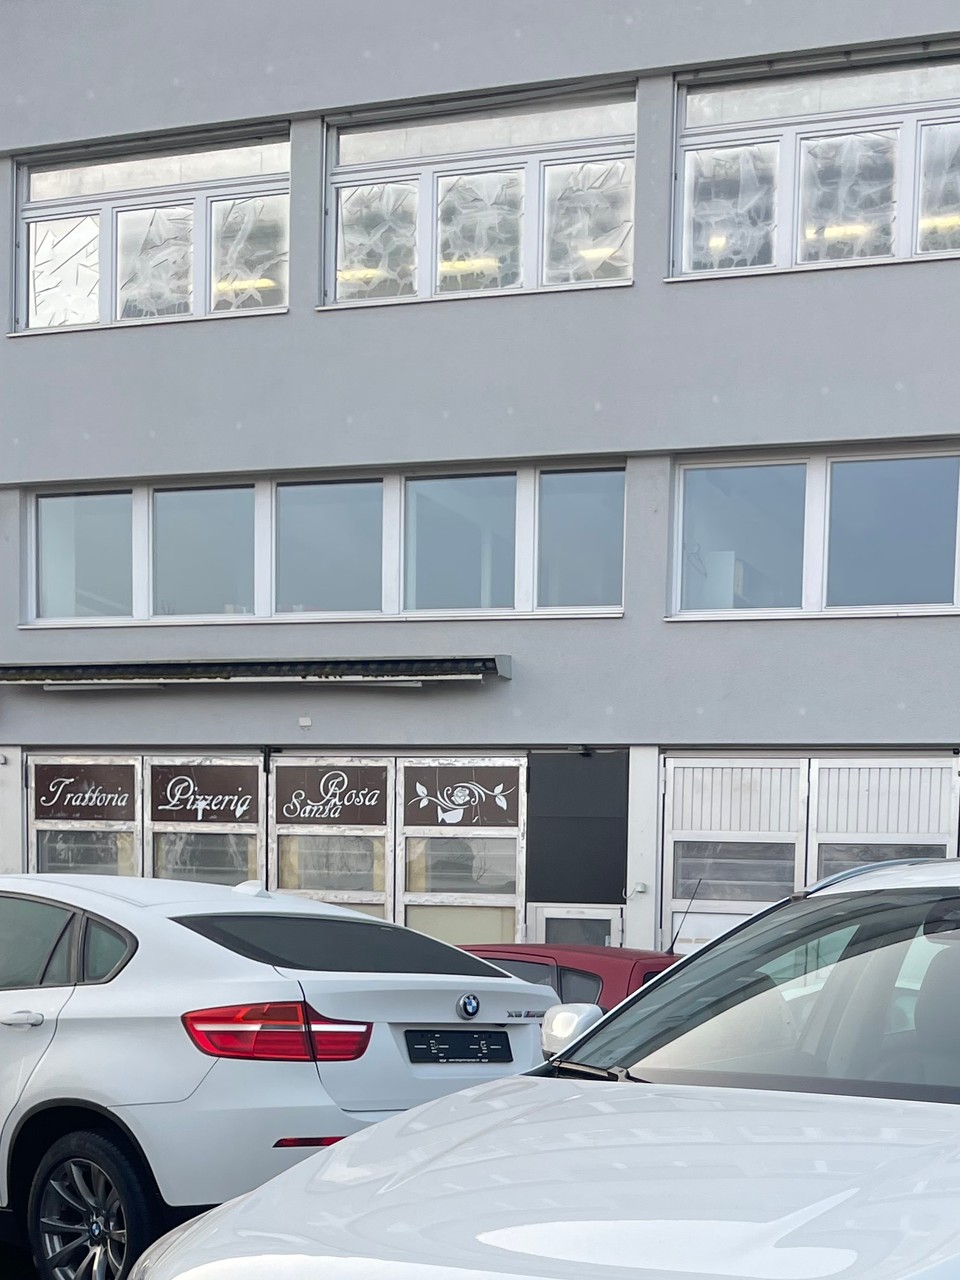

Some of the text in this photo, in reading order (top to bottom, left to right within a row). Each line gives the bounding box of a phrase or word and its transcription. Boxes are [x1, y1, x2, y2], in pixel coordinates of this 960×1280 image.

[40, 778, 129, 807] Trattoria
[283, 770, 380, 818] Santa Rosa
